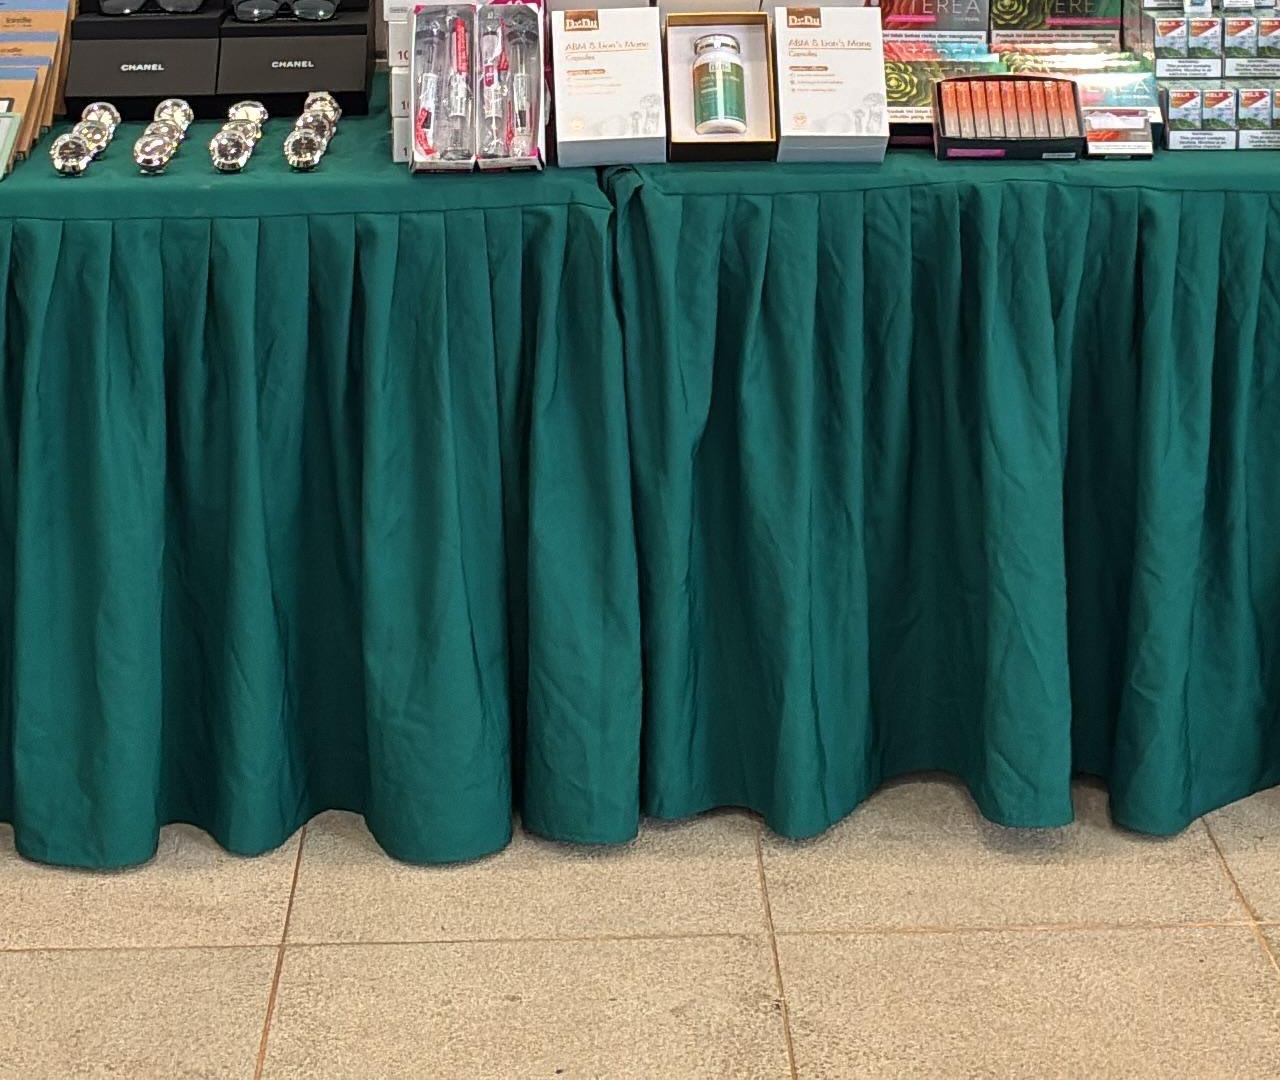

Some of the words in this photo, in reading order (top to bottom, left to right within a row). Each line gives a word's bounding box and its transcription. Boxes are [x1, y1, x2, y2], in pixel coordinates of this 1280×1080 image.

[788, 40, 809, 48] ABM
[120, 64, 165, 72] CHANEL
[271, 60, 314, 68] CHANEL
